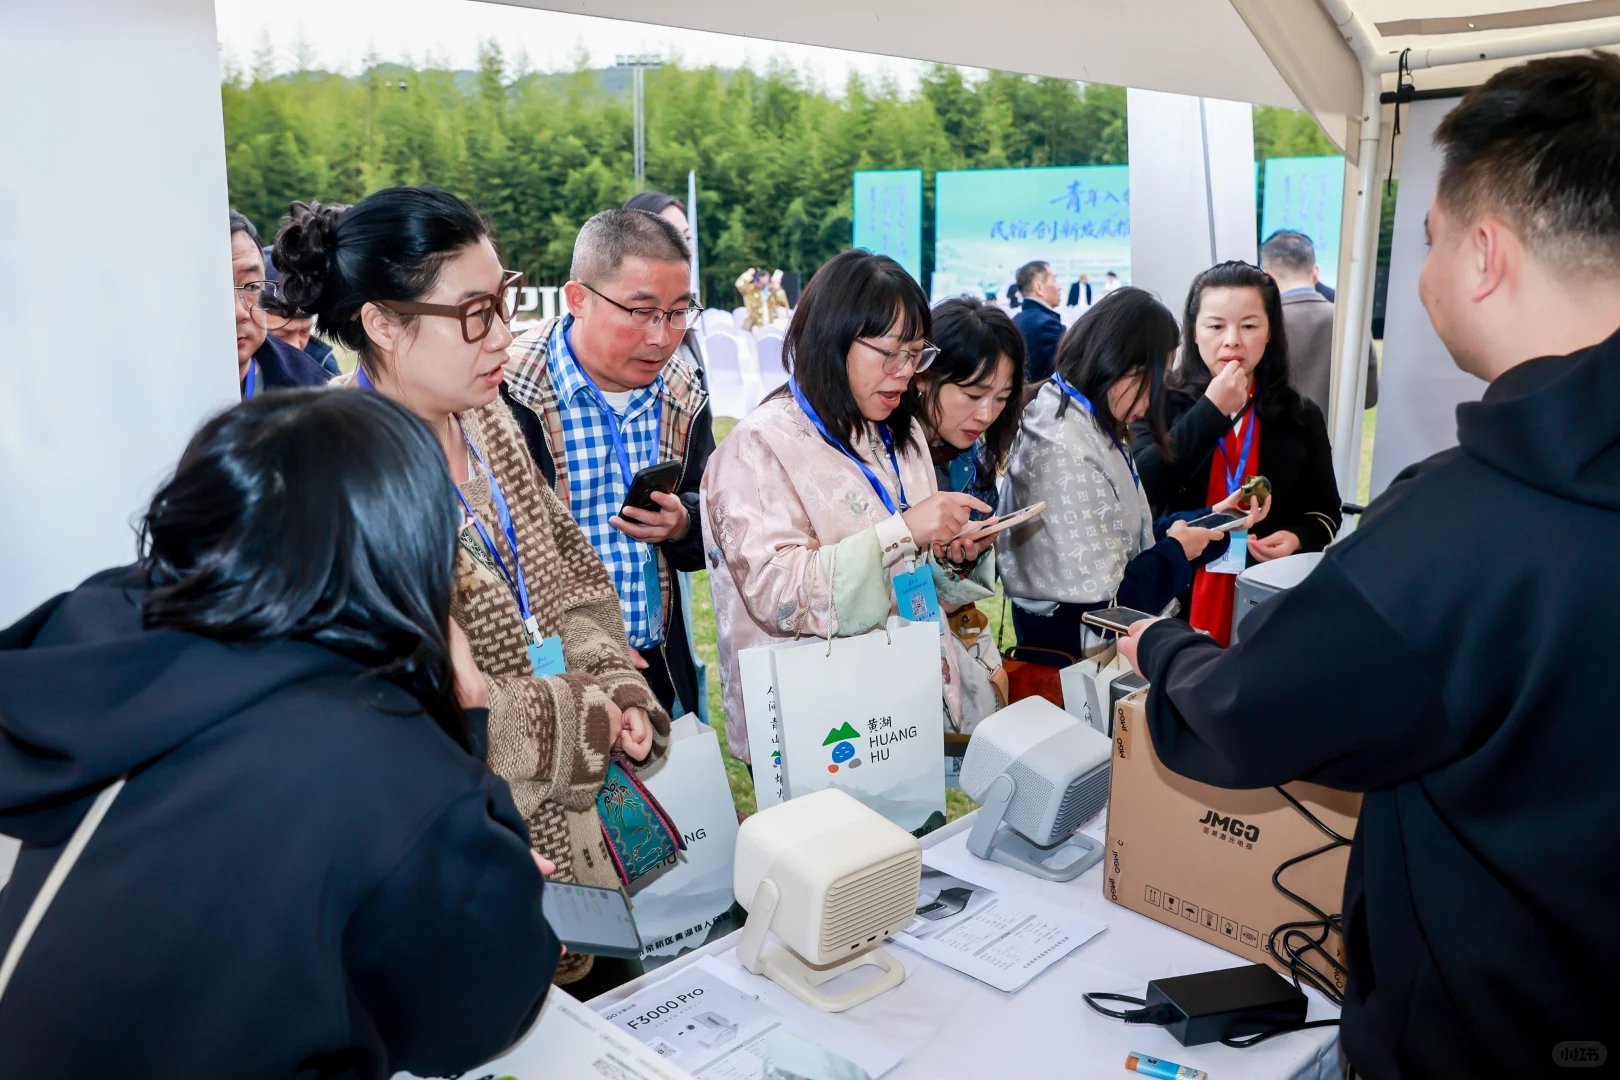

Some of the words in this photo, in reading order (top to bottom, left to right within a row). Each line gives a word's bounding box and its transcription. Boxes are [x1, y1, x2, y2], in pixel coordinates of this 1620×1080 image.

[867, 715, 892, 733] 黄湖
[869, 726, 917, 748] HUANG
[870, 747, 890, 763] HU
[1198, 809, 1260, 842] JMGO
[1111, 850, 1121, 874] JMGO
[1108, 877, 1118, 900] JMGO
[626, 1000, 679, 1030] F3000
[676, 988, 704, 1003] Pro
